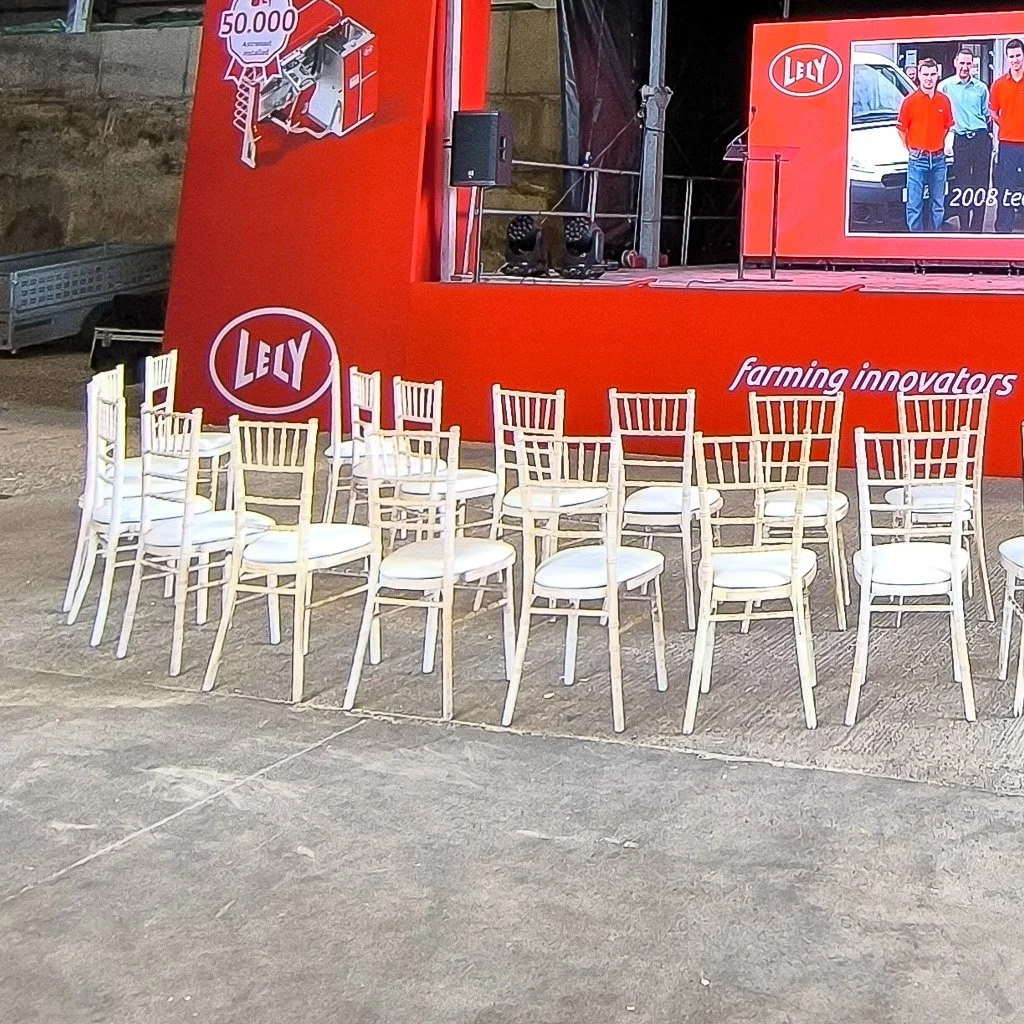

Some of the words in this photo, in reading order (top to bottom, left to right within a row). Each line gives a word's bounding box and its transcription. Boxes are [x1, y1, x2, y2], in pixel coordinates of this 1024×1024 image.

[221, 8, 296, 36] 50.000
[783, 52, 828, 88] LELY
[949, 187, 999, 207] 2008
[234, 328, 312, 391] LELY
[729, 356, 849, 395] farming
[851, 361, 1018, 395] innovators
